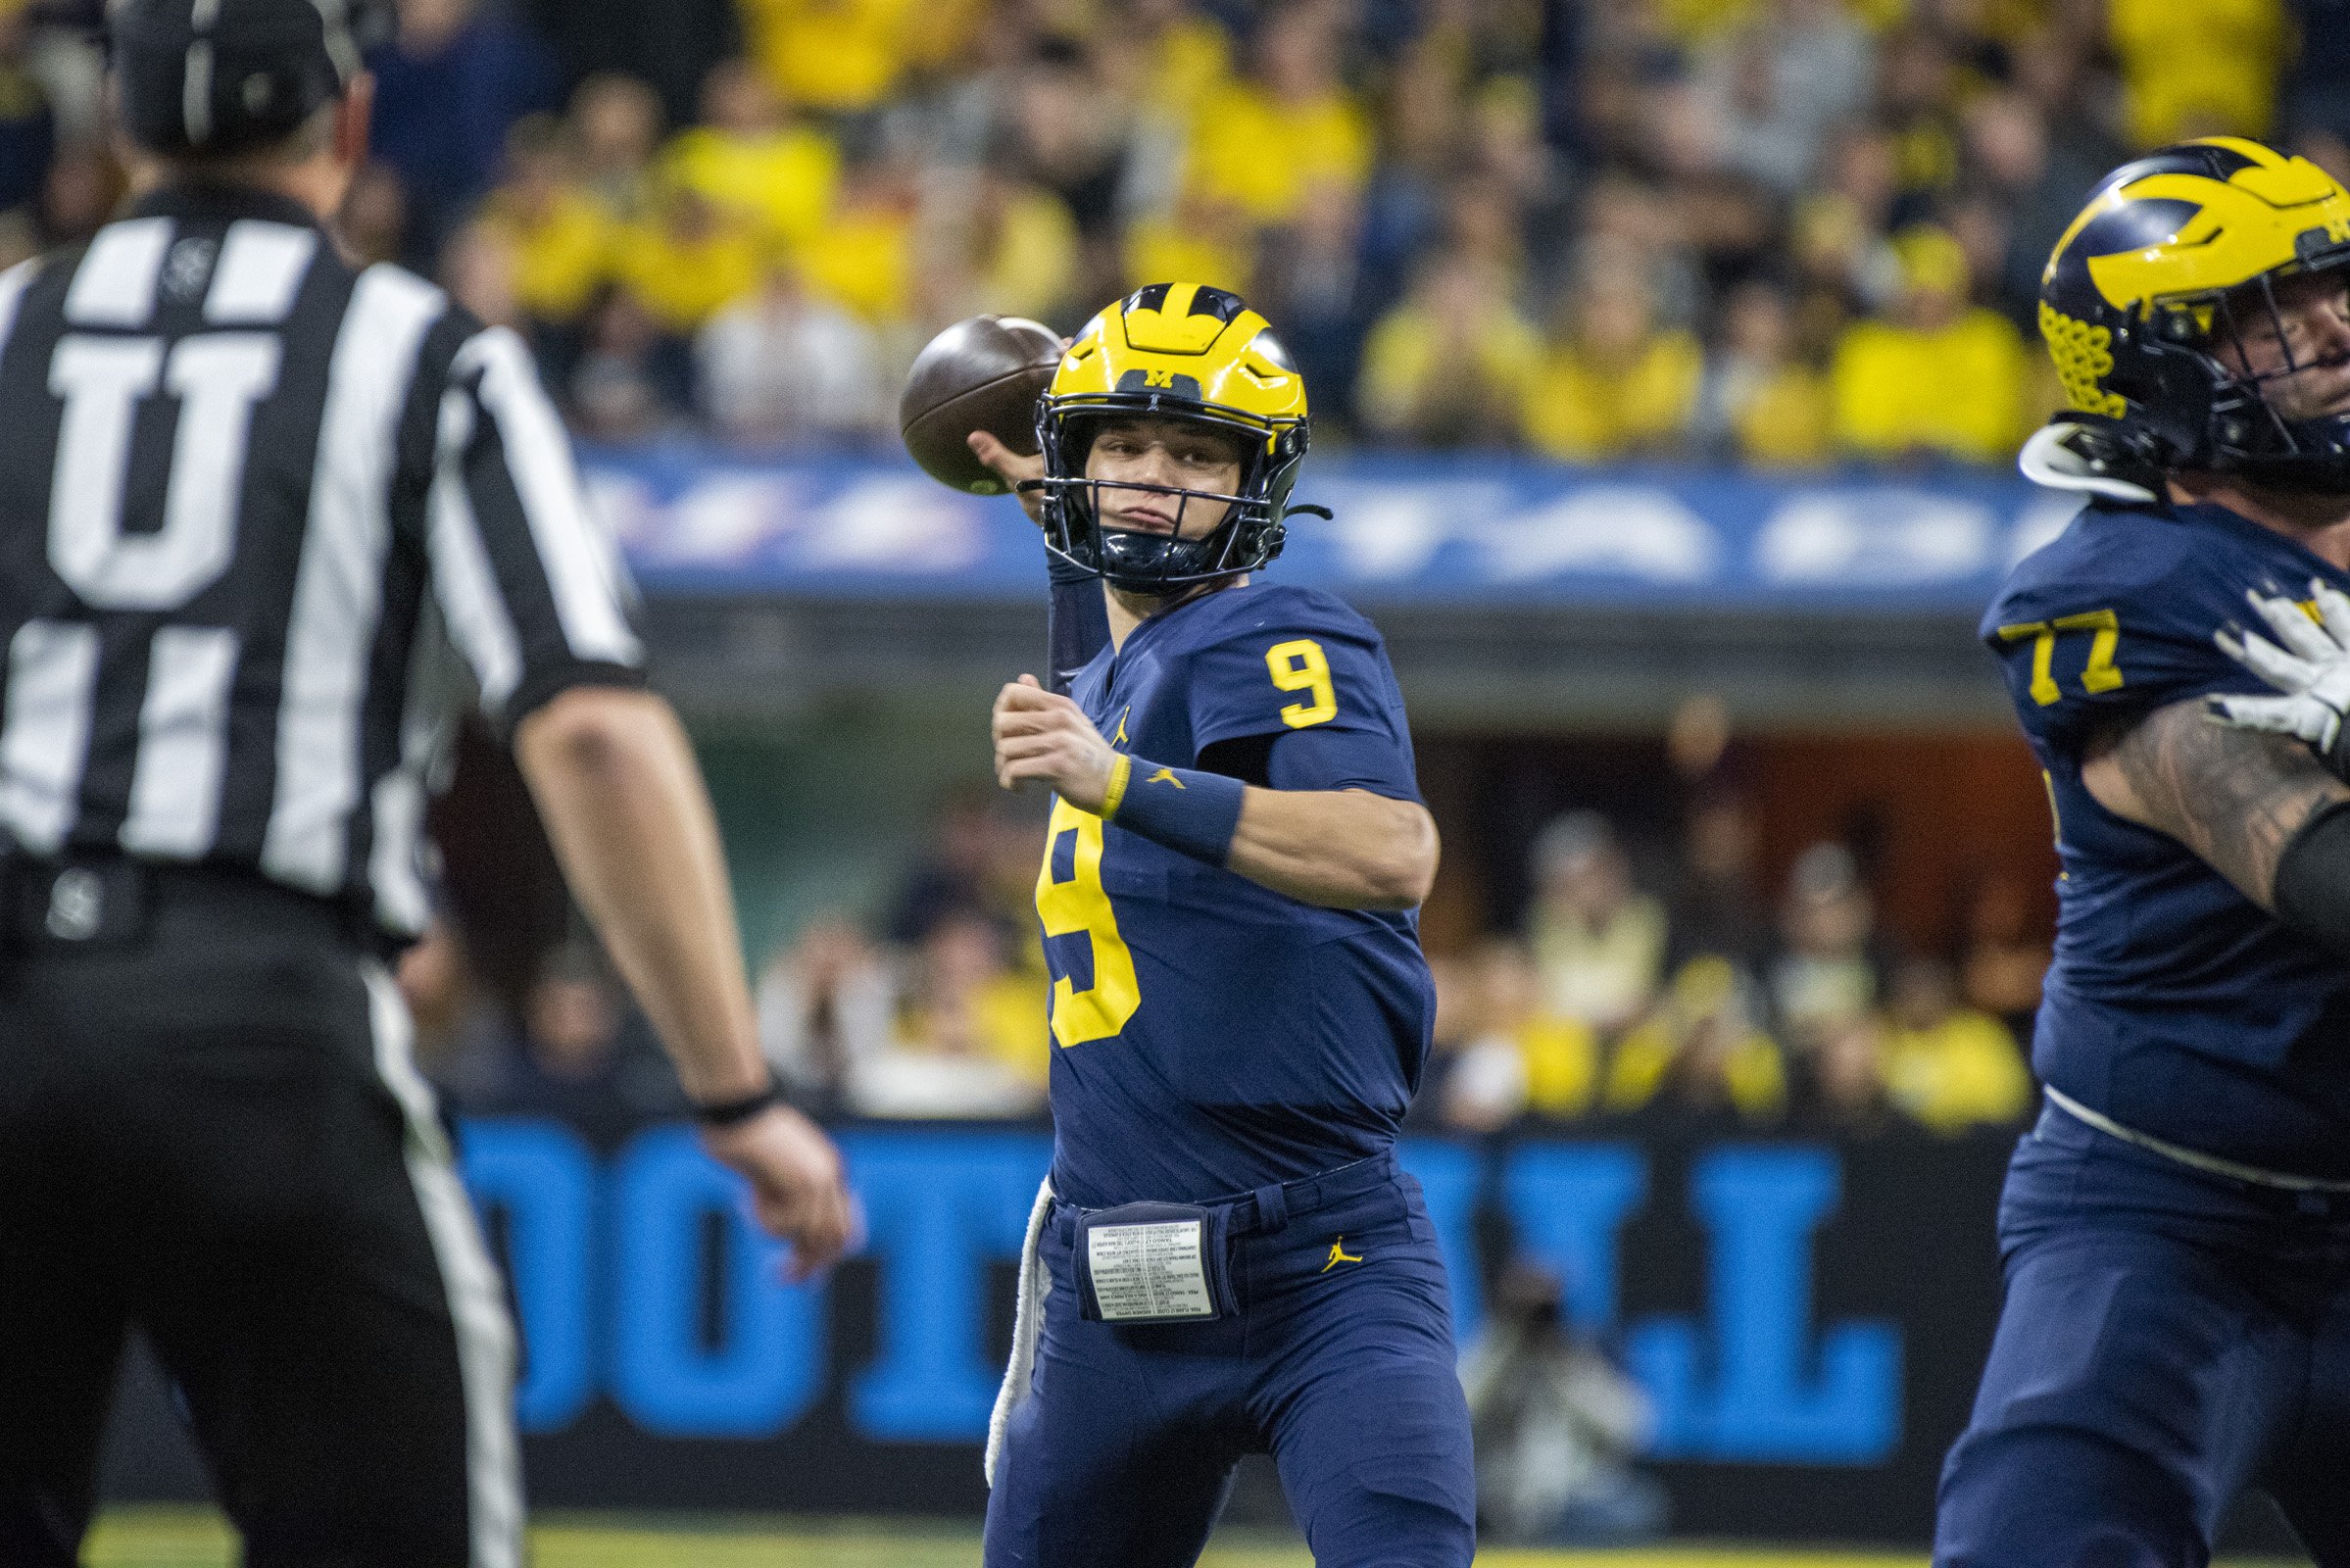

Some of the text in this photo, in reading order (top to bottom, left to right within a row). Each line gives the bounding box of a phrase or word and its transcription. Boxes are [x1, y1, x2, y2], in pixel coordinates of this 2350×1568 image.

[1144, 369, 1175, 389] M
[47, 331, 283, 611] U
[1265, 639, 1338, 729] 9
[1998, 609, 2125, 707] 77
[1035, 794, 1142, 1049] 9
